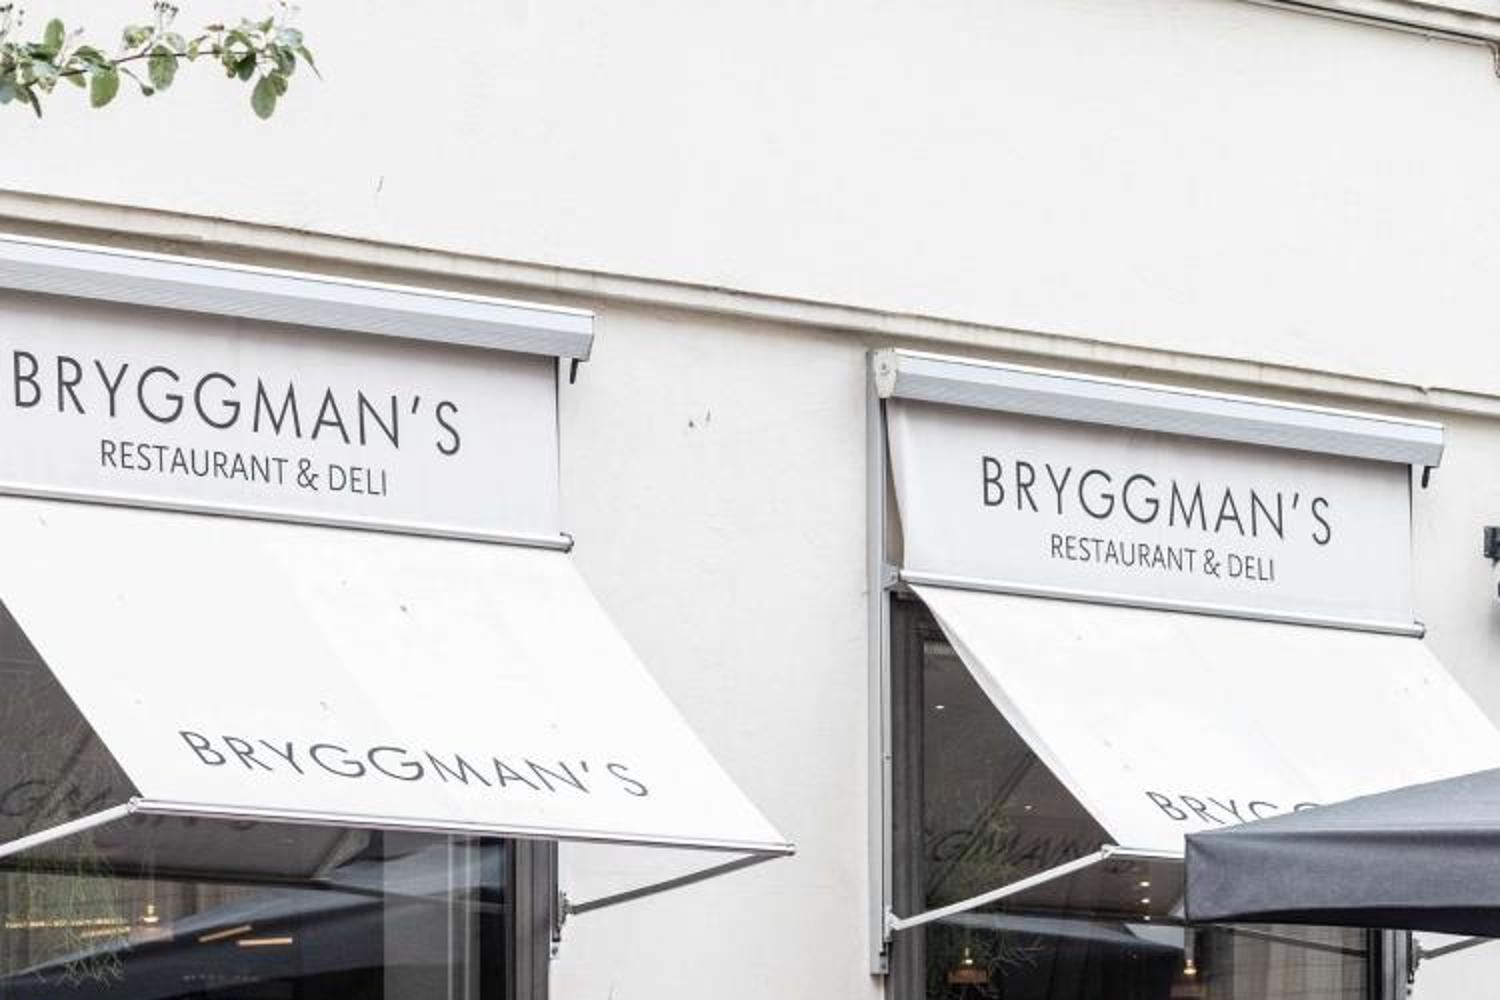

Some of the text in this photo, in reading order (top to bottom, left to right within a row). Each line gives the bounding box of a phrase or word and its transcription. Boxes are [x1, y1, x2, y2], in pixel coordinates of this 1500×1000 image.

[11, 350, 464, 458] BRYGGMAN'S
[99, 438, 389, 497] RESTAURANT & DELI
[981, 455, 1332, 546] BRYGGMAN'S
[1050, 533, 1275, 582] RESTAURANT & DELI
[178, 730, 650, 797] BRYGGMAN'S
